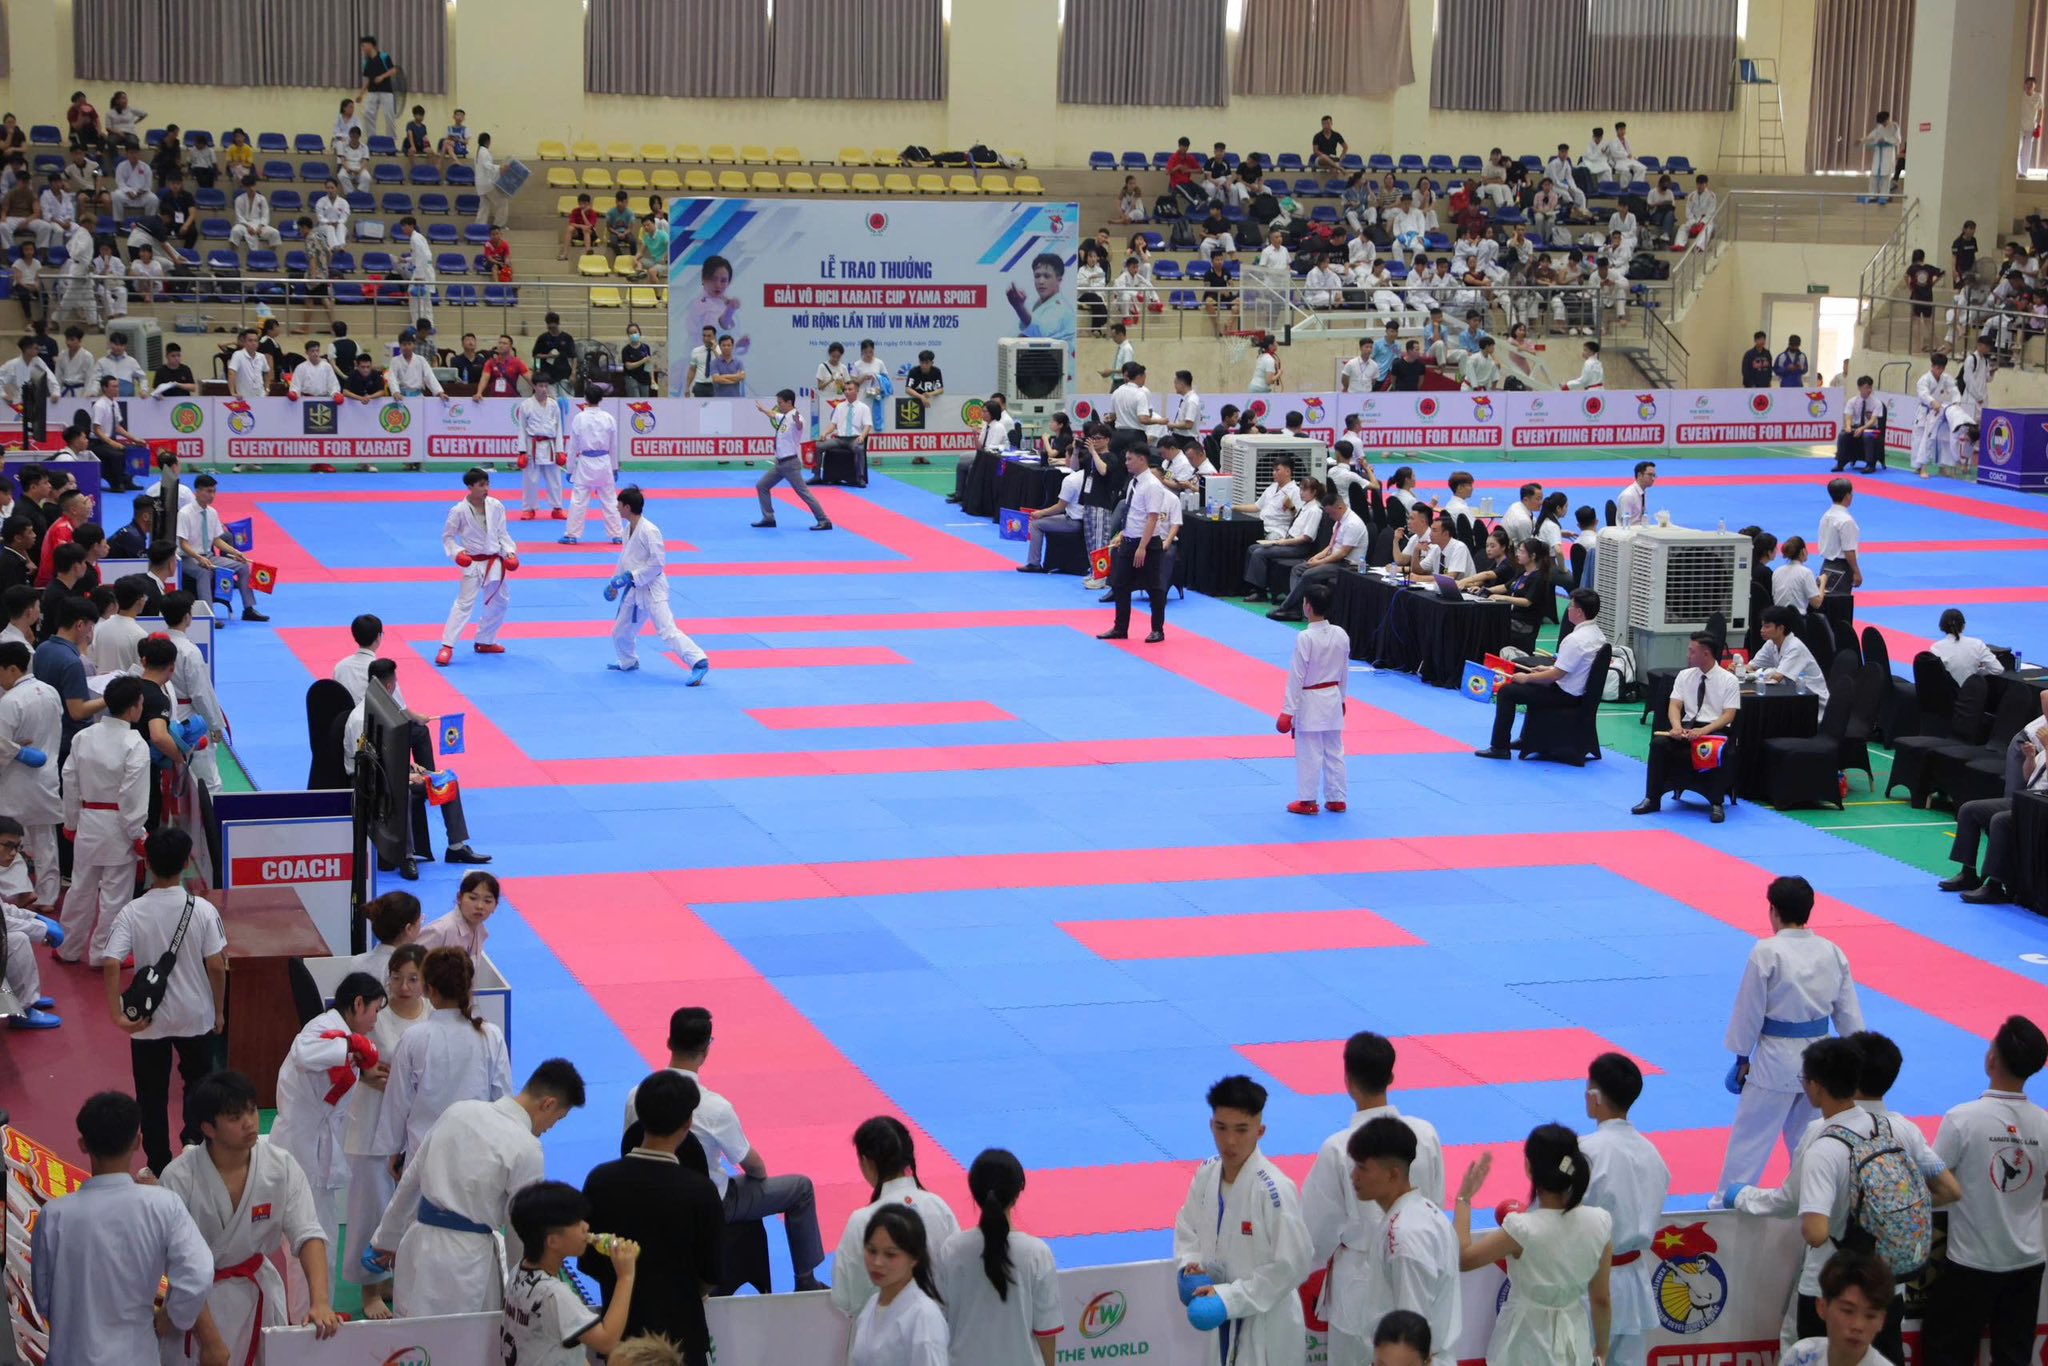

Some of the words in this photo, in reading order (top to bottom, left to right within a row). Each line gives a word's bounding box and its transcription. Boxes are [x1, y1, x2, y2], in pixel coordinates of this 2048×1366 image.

[820, 254, 836, 279] LỄ
[840, 260, 876, 279] TRAO
[880, 255, 932, 279] THƯỞNG
[774, 285, 796, 304] GIẢI
[798, 286, 813, 304] VÔ
[841, 290, 884, 304] KARATE
[885, 290, 906, 304] CUP
[908, 290, 941, 304] YAMA
[944, 290, 977, 304] SPORT
[792, 310, 808, 328] MỞ
[812, 312, 840, 331] RỘNG
[866, 312, 885, 328] THỨ
[889, 314, 902, 328] VII
[905, 312, 930, 328] NĂM
[933, 315, 959, 328] 2025
[1426, 429, 1449, 444] FOR
[1452, 428, 1498, 443] KARATE
[1516, 428, 1588, 444] EVERYTHING
[1592, 428, 1613, 443] FOR
[1617, 427, 1660, 442] KARATE
[1680, 426, 1756, 442] EVERYTHING
[1759, 425, 1782, 440] FOR
[1786, 424, 1832, 439] KARATE
[177, 441, 201, 455] ATE
[231, 441, 319, 455] EVERYTHING
[324, 441, 351, 455] FOR
[355, 441, 408, 456] KARATE
[634, 440, 714, 454] EVERYTHING
[719, 440, 744, 454] FOR
[748, 439, 775, 453] KAR
[913, 435, 937, 449] FOR
[1989, 471, 2007, 481] COACH
[262, 858, 340, 880] COACH
[1056, 1347, 1086, 1363] THE
[1091, 1341, 1149, 1359] WORLD
